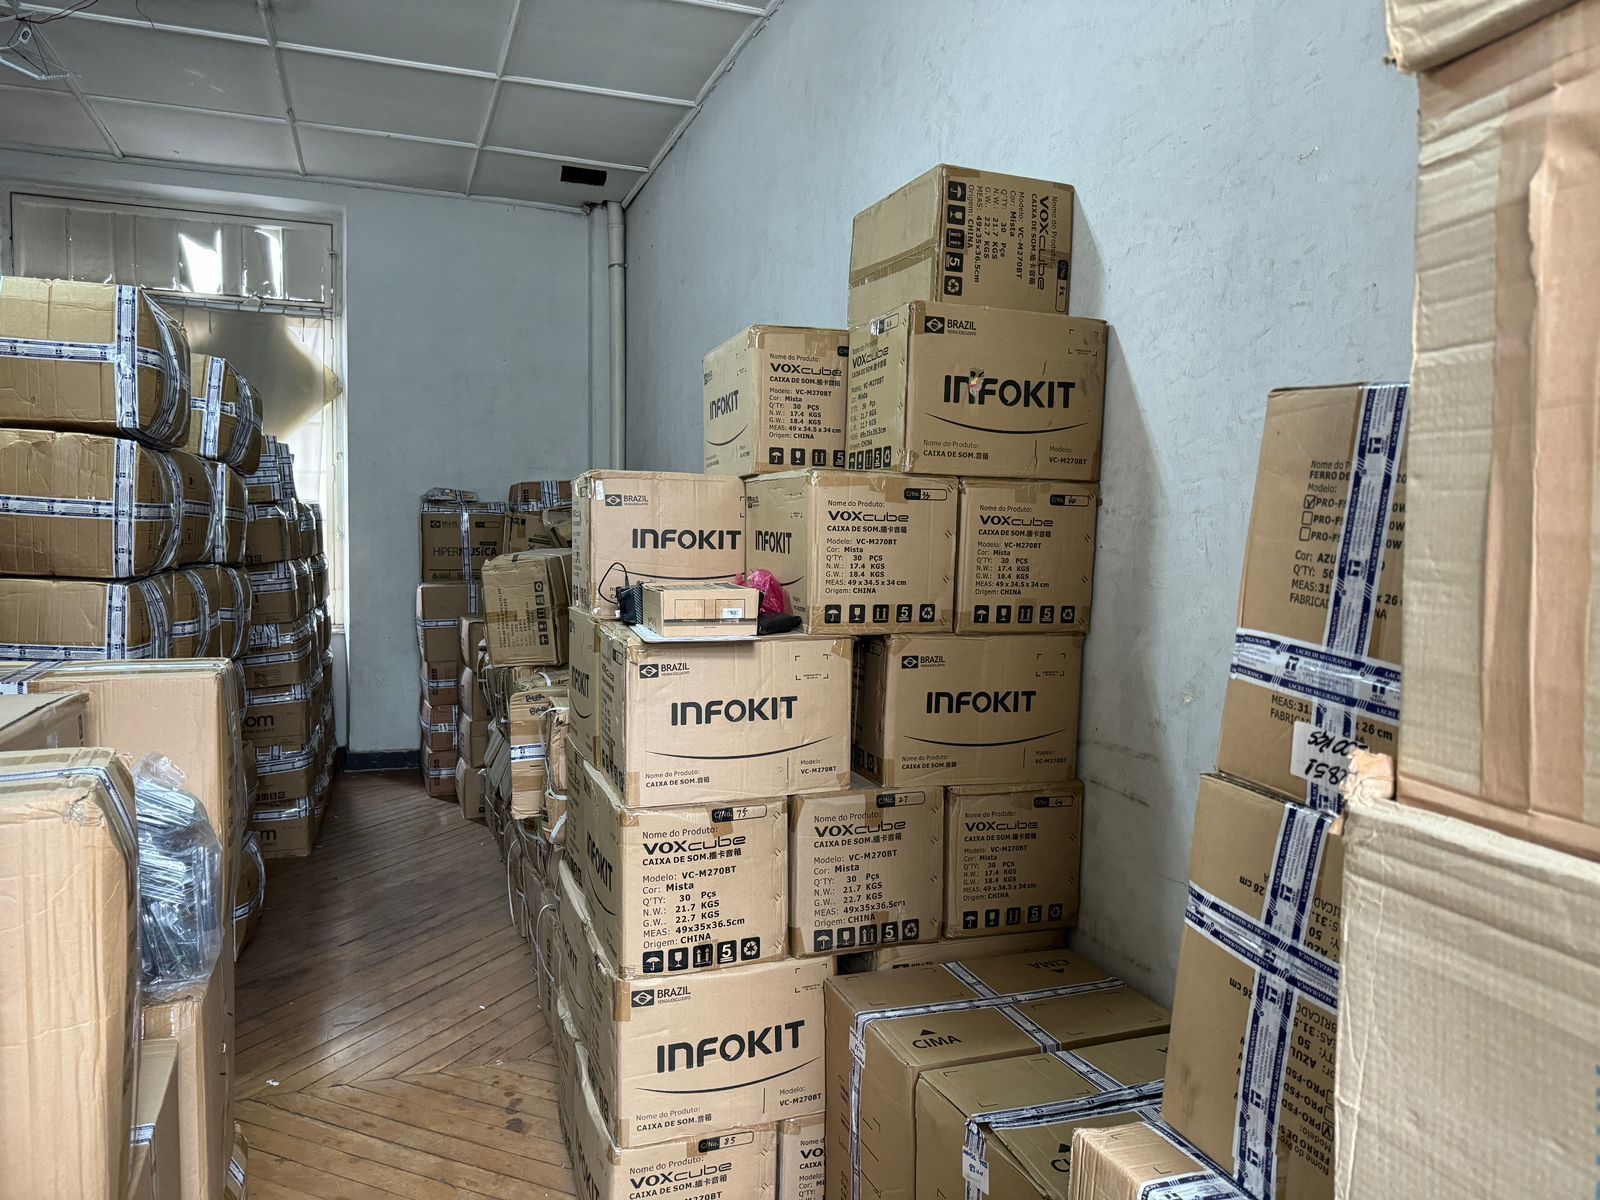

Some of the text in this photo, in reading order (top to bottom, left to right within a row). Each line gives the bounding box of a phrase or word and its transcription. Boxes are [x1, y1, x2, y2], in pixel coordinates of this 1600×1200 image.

[1051, 221, 1057, 229] do
[1037, 196, 1049, 290] VOXcube
[1016, 227, 1024, 279] VC-M270BT
[947, 319, 977, 330] BRAZIL
[770, 363, 842, 376] VOXcube
[943, 374, 1076, 409] INFOKIT
[952, 441, 979, 449] Produto:
[1049, 446, 1072, 454] Modelo:
[1049, 457, 1087, 465] VC-M270BT
[1311, 460, 1344, 470] Nome do
[1309, 471, 1350, 480] FERRO DE
[1307, 483, 1337, 493] Modelo:
[828, 511, 909, 522] VOXcube
[980, 515, 1053, 527] VOXcube
[632, 528, 741, 550] INFOKIT
[755, 530, 792, 554] INFOKIT
[1295, 550, 1312, 562] Cor:
[920, 656, 946, 664] BRAZIL
[661, 663, 689, 672] BRAZIL
[926, 691, 1036, 713] INFOKIT
[671, 696, 798, 726] INFOKIT
[1362, 721, 1393, 741] 26 cm
[800, 766, 836, 774] VC-M270BT
[814, 821, 906, 837] VOXcube
[965, 821, 1038, 832] VOXcube
[642, 831, 667, 839] Nome
[682, 827, 718, 836] Produto:
[643, 836, 746, 855] VOXcube
[643, 857, 671, 866] CAIXA
[814, 849, 898, 864] Modelo: VC-M270BT
[642, 865, 737, 883] Modelo: VC-M270BT
[814, 864, 860, 875] Cor: Mista
[642, 882, 694, 894] Cor: Mista
[643, 897, 666, 906] Q'TY:
[679, 894, 691, 902] 30
[643, 900, 720, 916] N.W.: 21.7 KGS
[814, 909, 839, 917] MEAS:
[814, 914, 875, 928] Origem: CHINA
[643, 918, 745, 938] MEAS: 49x35x36.5cm
[643, 933, 711, 949] Origem: CHINA
[657, 986, 691, 998] BRAZIL
[657, 1019, 805, 1073] INFOKIT
[912, 1035, 962, 1048] CIMA
[780, 1086, 805, 1095] Modelo:
[779, 1092, 822, 1106] VC-M270BT
[636, 1112, 657, 1121] Nome
[669, 1106, 700, 1117] Produto:
[636, 1122, 662, 1132] CAIXA
[800, 1138, 819, 1146] Nome
[629, 1155, 704, 1175] Nome do Produto:
[800, 1161, 822, 1169] CAIXA
[630, 1162, 732, 1189] VOXcube
